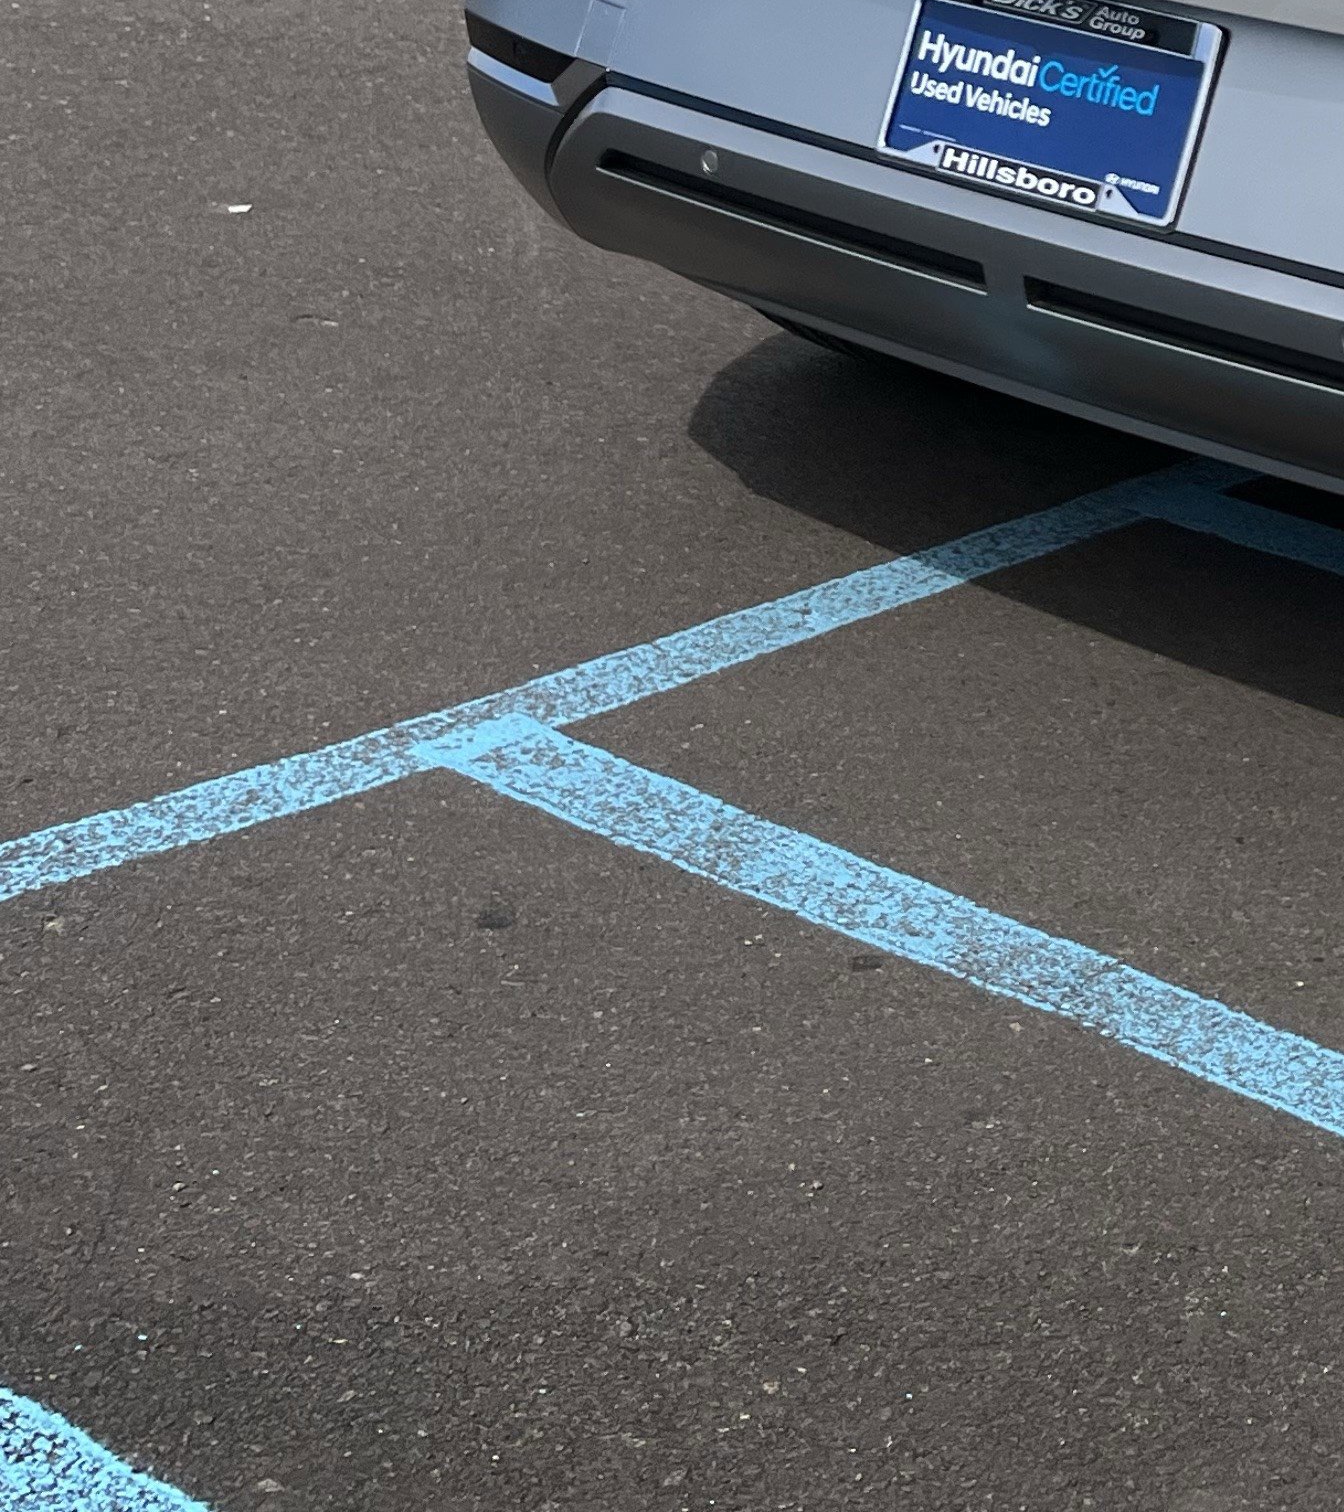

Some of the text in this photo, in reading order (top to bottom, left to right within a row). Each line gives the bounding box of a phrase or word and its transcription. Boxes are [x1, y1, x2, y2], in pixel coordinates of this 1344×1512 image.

[1088, 16, 1146, 40] Group
[1096, 6, 1140, 25] Auto
[910, 70, 1052, 127] Used Vehicles
[917, 29, 1160, 117] Hyundai Certified
[941, 147, 1097, 206] Hillsboro
